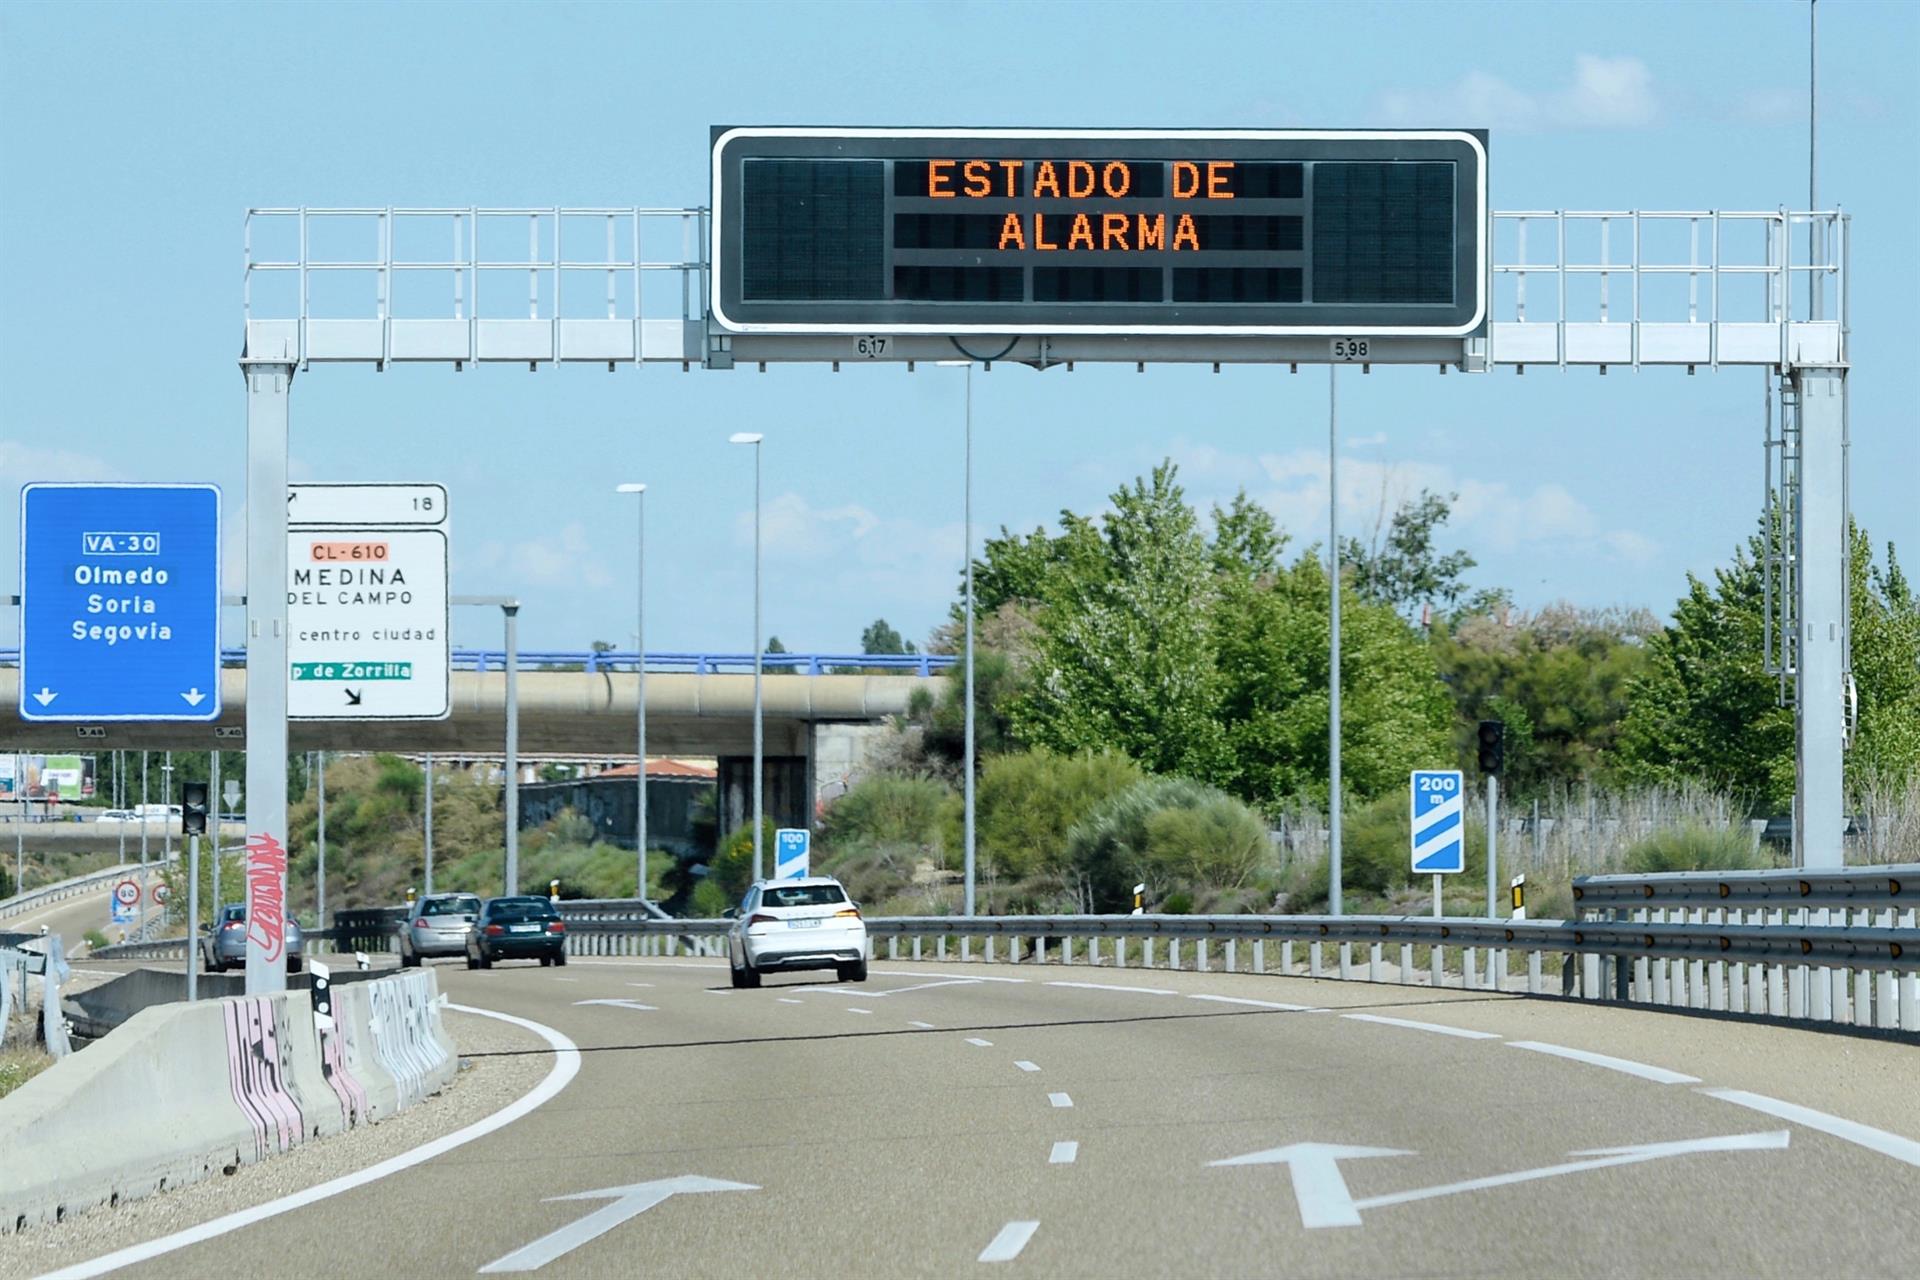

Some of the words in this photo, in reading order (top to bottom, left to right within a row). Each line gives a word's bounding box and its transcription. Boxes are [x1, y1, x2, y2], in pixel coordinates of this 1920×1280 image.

[929, 160, 1131, 198] ESTADO
[1172, 161, 1235, 198] DE
[999, 213, 1199, 250] ALARMA
[413, 497, 433, 511] 18
[86, 536, 156, 551] VA-30
[312, 545, 386, 560] CL-610
[74, 565, 169, 585] Olmedo
[294, 569, 406, 586] MEDINA
[87, 594, 156, 614] Soria
[287, 592, 327, 605] DEL
[337, 591, 412, 605] CAMPO
[72, 620, 172, 646] Segovia
[299, 628, 361, 641] centro
[372, 628, 436, 641] ciudad
[313, 664, 335, 678] de
[341, 664, 411, 678] Zorrilla
[1420, 777, 1455, 792] 200
[1430, 794, 1444, 804] m
[781, 833, 804, 844] 100
